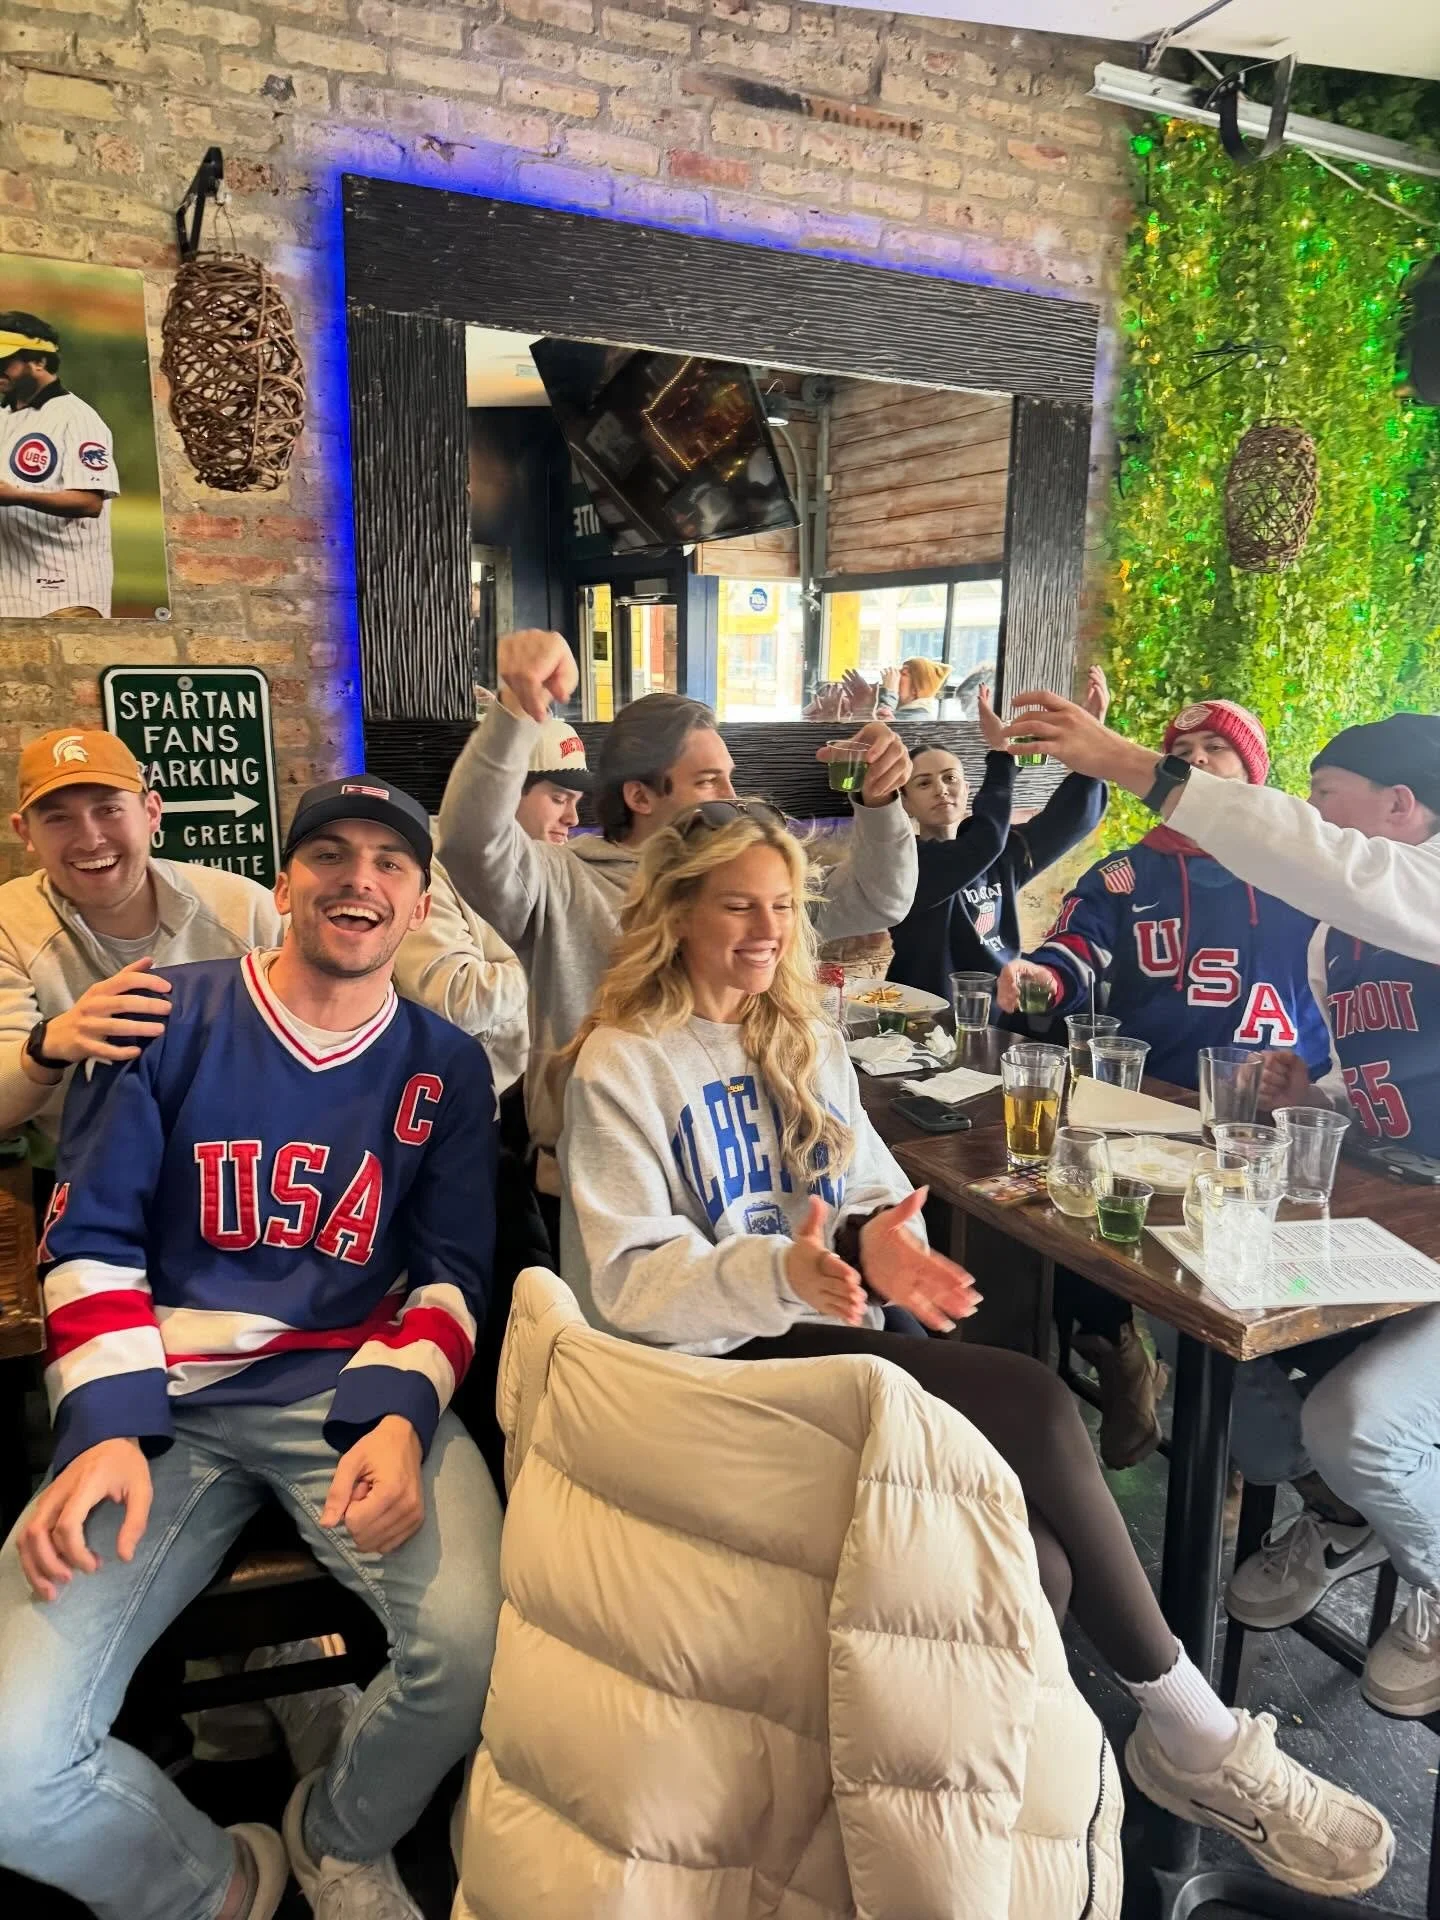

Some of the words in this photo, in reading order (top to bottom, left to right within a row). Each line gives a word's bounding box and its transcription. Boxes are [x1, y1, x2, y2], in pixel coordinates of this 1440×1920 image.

[18, 441, 48, 473] CUBS
[120, 691, 257, 720] SPARTAN
[144, 725, 239, 754] FANS
[151, 830, 165, 849] O
[183, 822, 265, 848] GREEN
[1105, 861, 1127, 873] USA
[1133, 917, 1298, 1047] USA
[1328, 981, 1420, 1040] TROIT
[394, 1073, 443, 1147] C
[194, 1139, 384, 1267] USA
